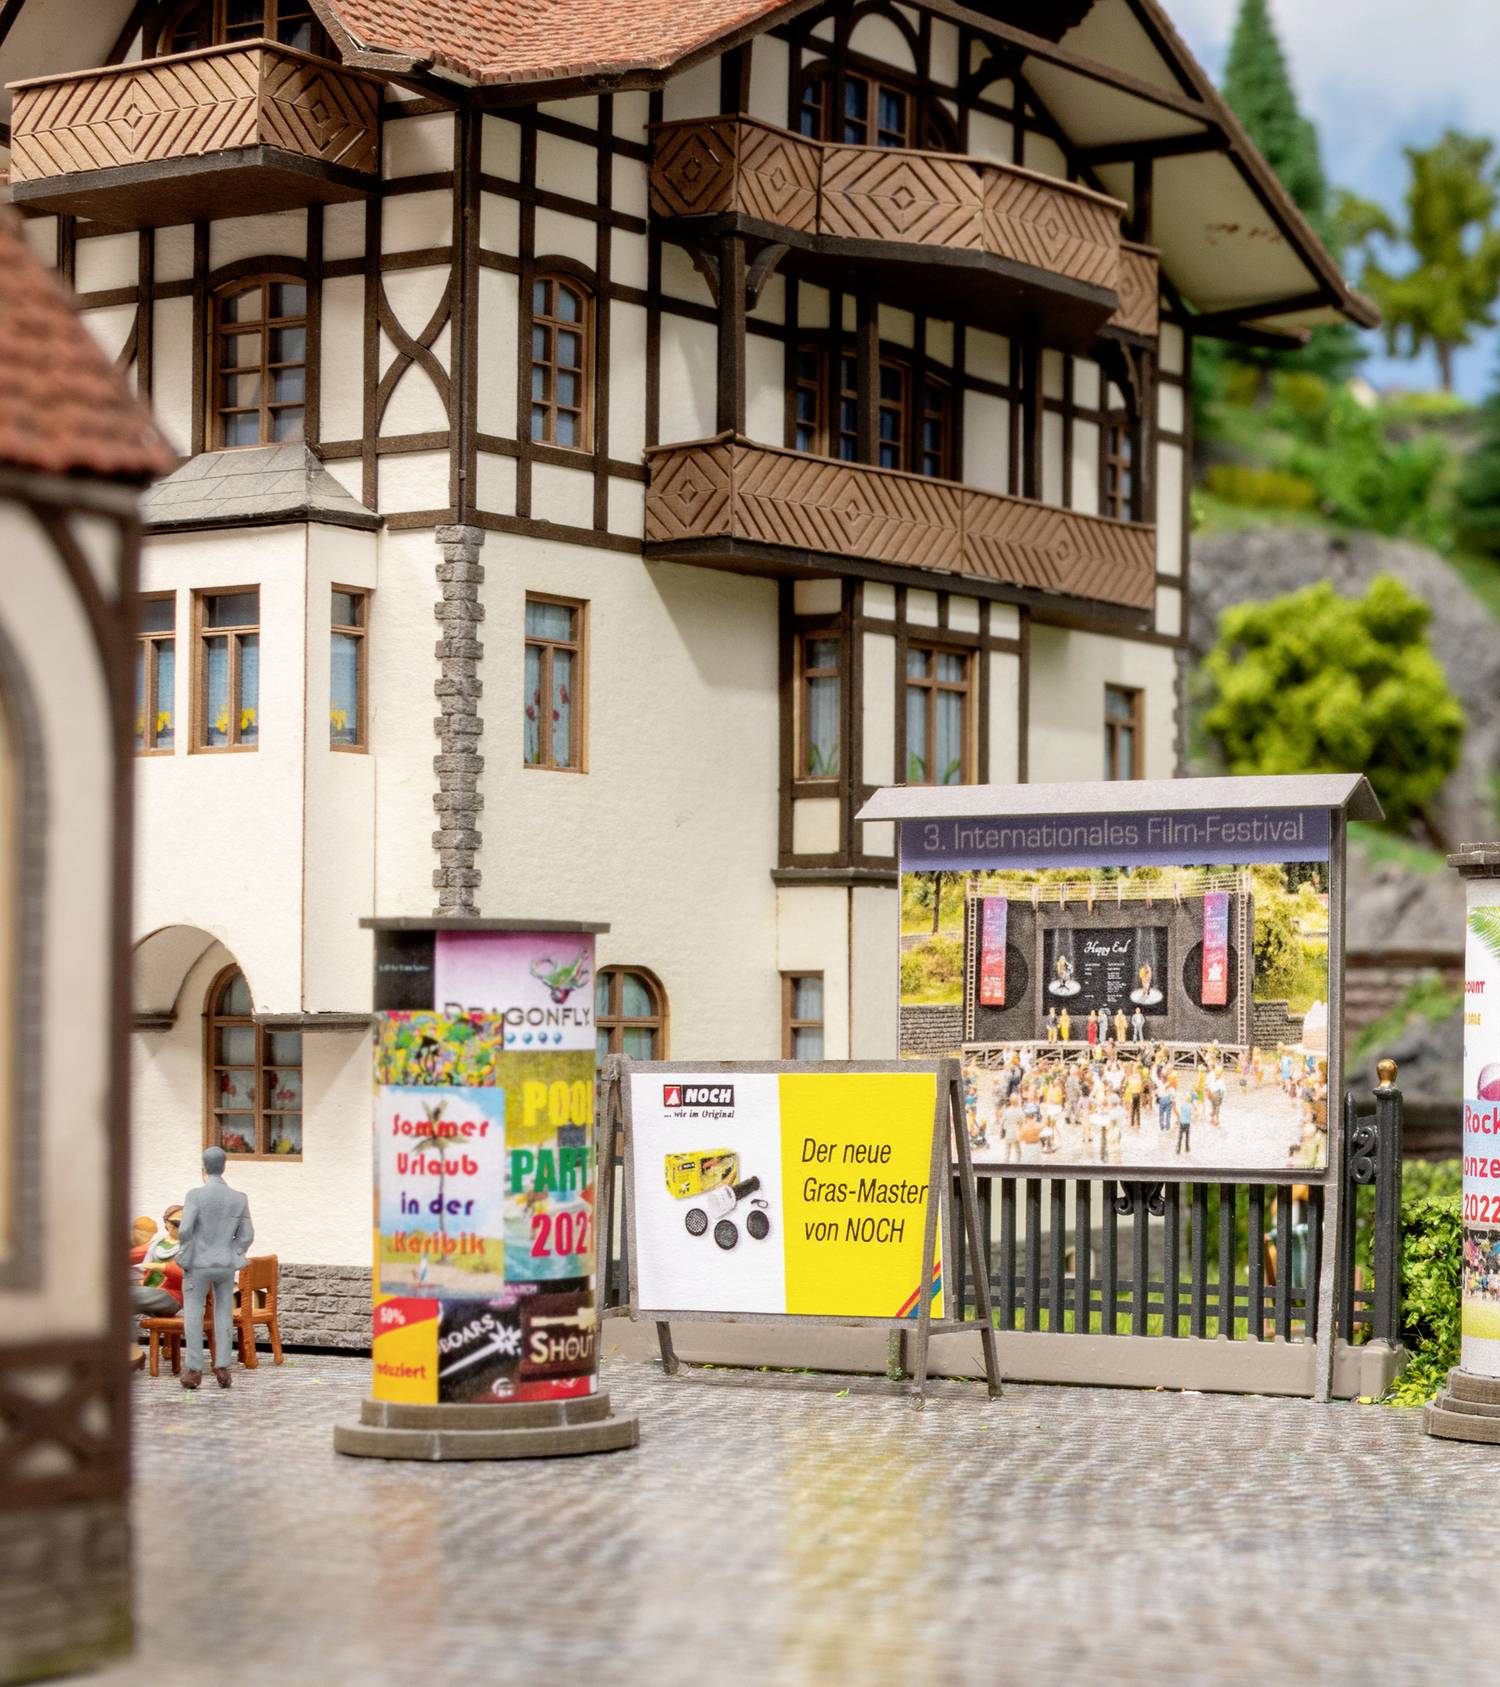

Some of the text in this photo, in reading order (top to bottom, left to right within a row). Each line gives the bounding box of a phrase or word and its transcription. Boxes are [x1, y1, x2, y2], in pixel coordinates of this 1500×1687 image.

[923, 813, 1304, 850] 3. Internationales Film-Festival
[1084, 939, 1131, 957] Happy End
[685, 1088, 731, 1103] NOCH
[393, 1113, 489, 1137] Sommer
[689, 1109, 699, 1118] im
[702, 1108, 735, 1120] Original
[802, 1137, 891, 1164] Der neue
[397, 1153, 478, 1176] Urlaub
[511, 1147, 588, 1193] PART
[401, 1191, 474, 1216] in der
[803, 1177, 928, 1205] Gras-Master
[531, 1210, 588, 1258] 202
[805, 1217, 904, 1243] von NOCH
[392, 1231, 485, 1256] Karibik
